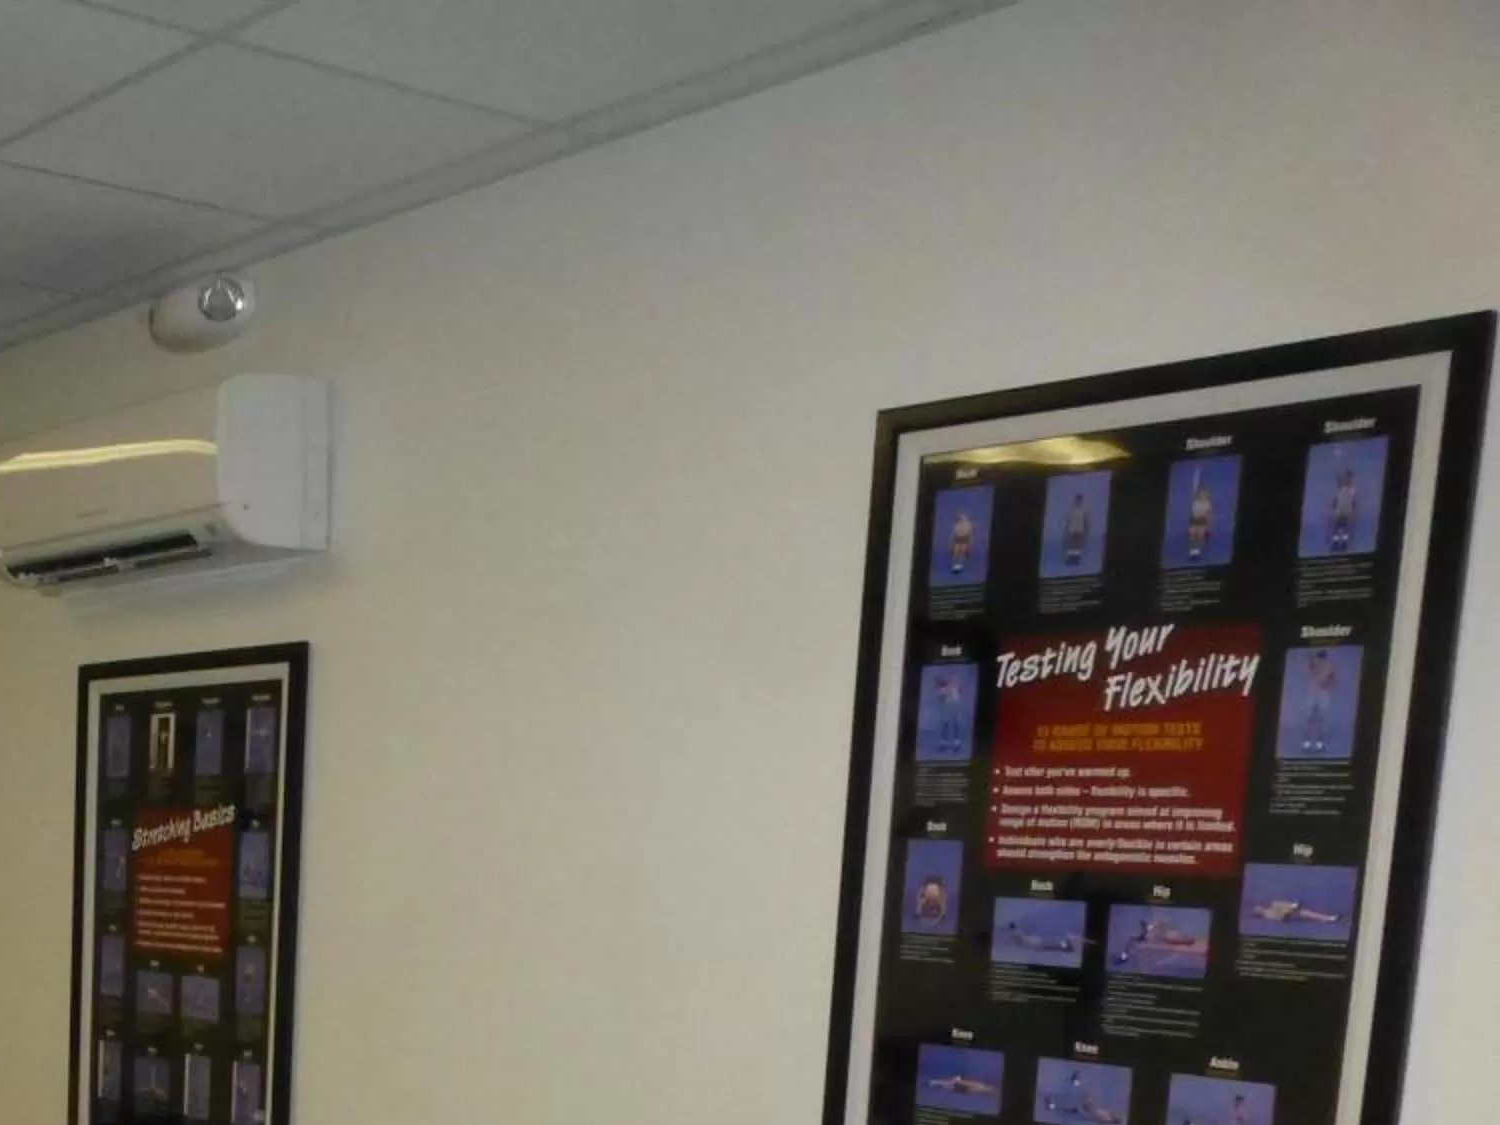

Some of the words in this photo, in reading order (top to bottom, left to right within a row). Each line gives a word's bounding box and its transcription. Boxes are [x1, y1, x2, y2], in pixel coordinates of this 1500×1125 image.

[996, 640, 1097, 689] Testing
[1104, 624, 1175, 670] Your
[1104, 652, 1260, 711] Flexibility
[131, 815, 192, 850] Stretching
[192, 804, 237, 832] Basics
